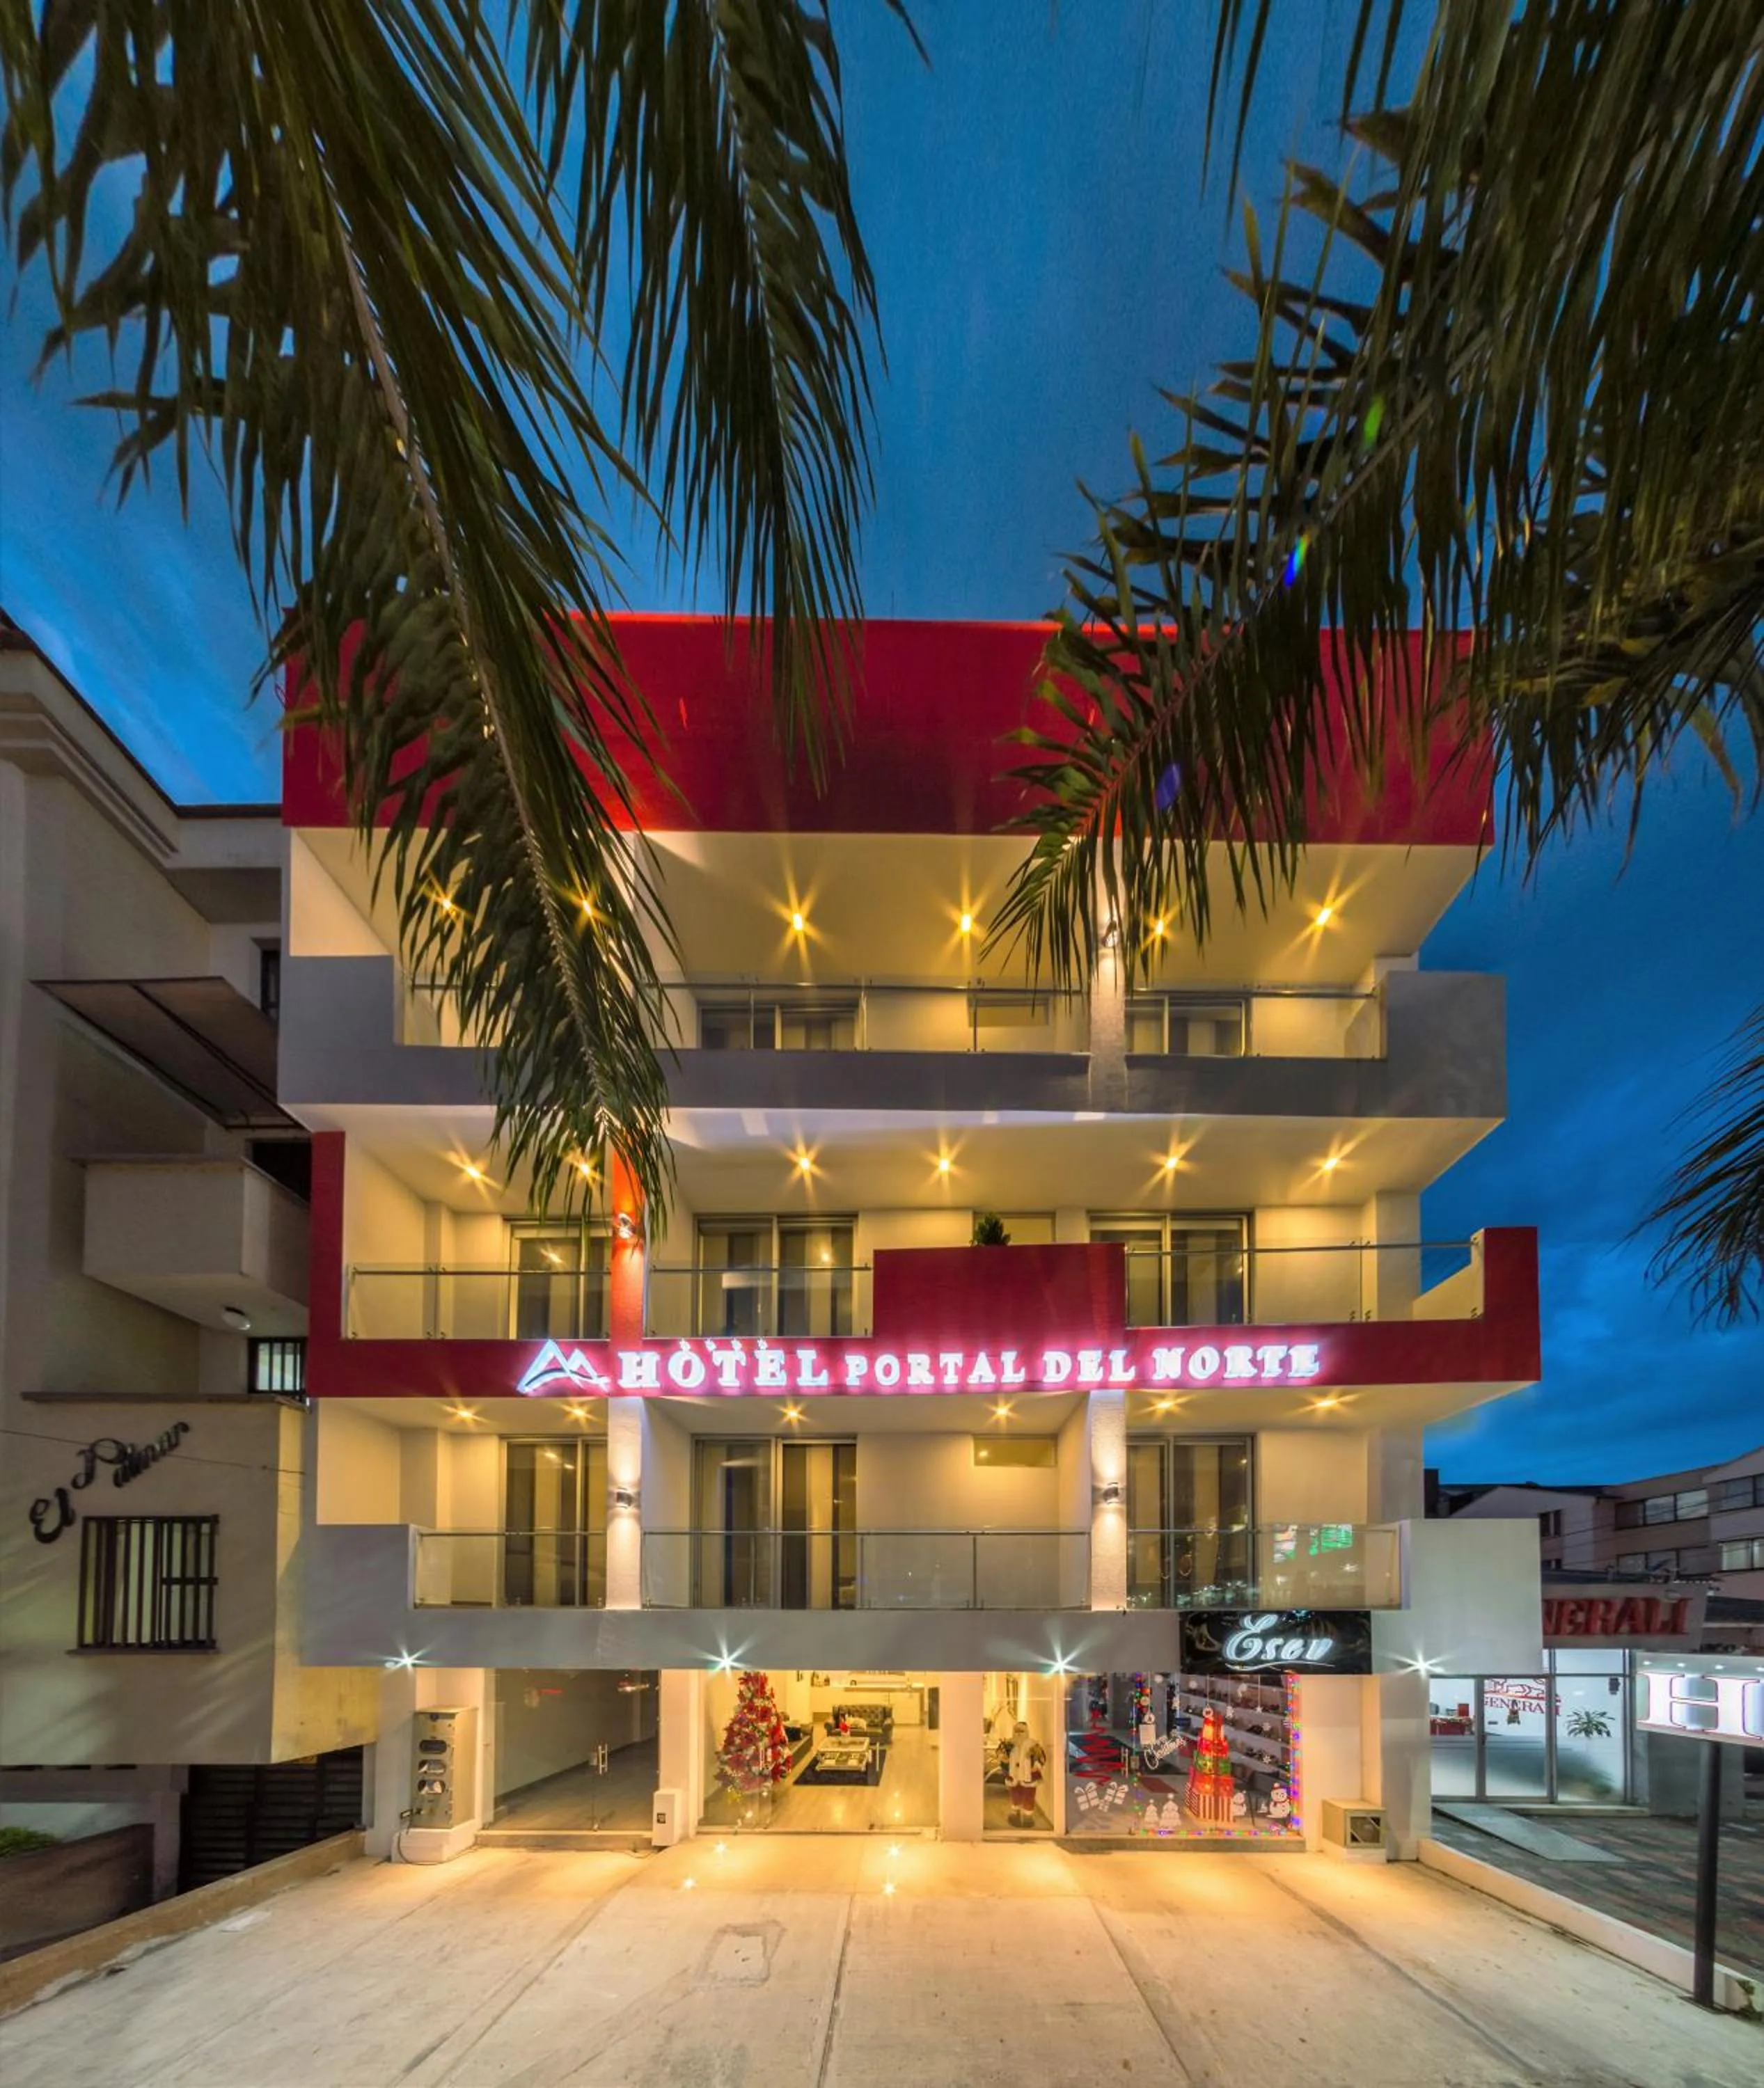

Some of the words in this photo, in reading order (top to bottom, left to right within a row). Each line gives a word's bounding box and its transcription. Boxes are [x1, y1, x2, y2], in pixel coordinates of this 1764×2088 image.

[617, 1349, 828, 1388] HOTEL
[844, 1351, 1026, 1385] PORTAL
[1043, 1350, 1136, 1383] DEL
[1151, 1345, 1320, 1380] NORTE
[29, 1487, 76, 1544] El
[1483, 1696, 1560, 1716] ENERAI
